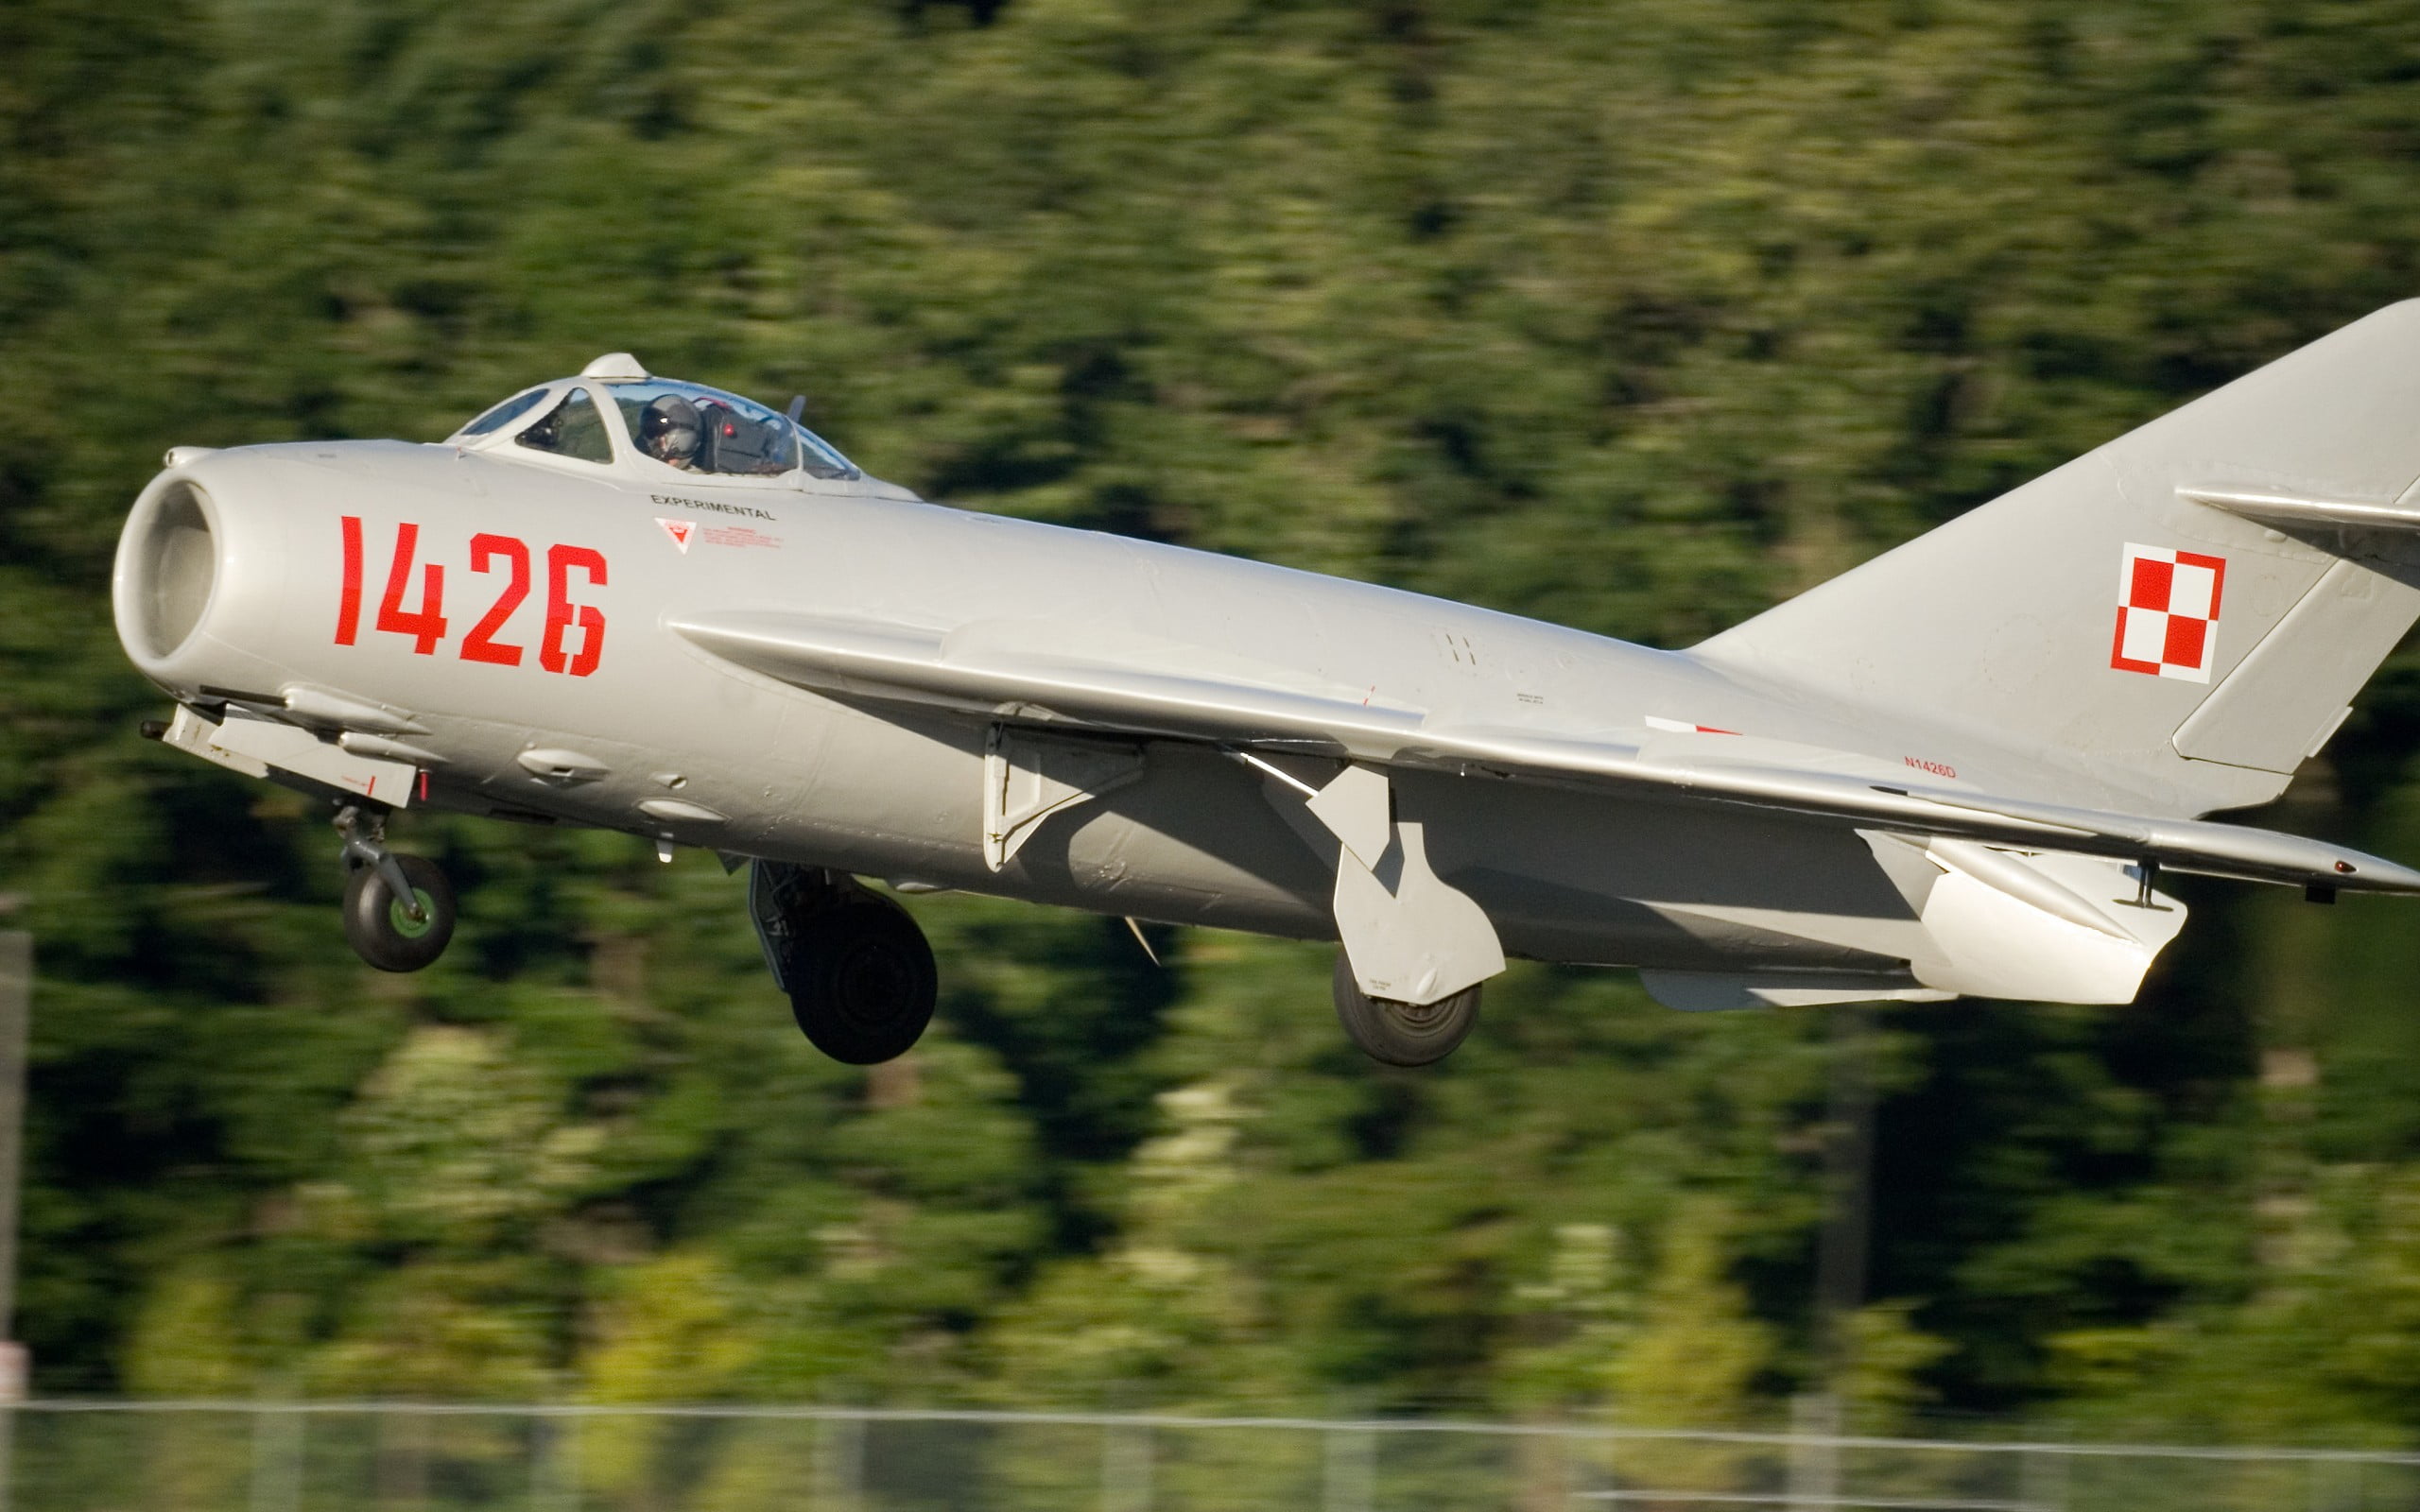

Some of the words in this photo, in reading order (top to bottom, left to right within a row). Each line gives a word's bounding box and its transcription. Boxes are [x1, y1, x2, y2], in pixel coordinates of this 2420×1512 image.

[650, 494, 777, 521] EXPERIMENTAL
[335, 516, 607, 677] 1426
[1905, 756, 1956, 778] N1426D
